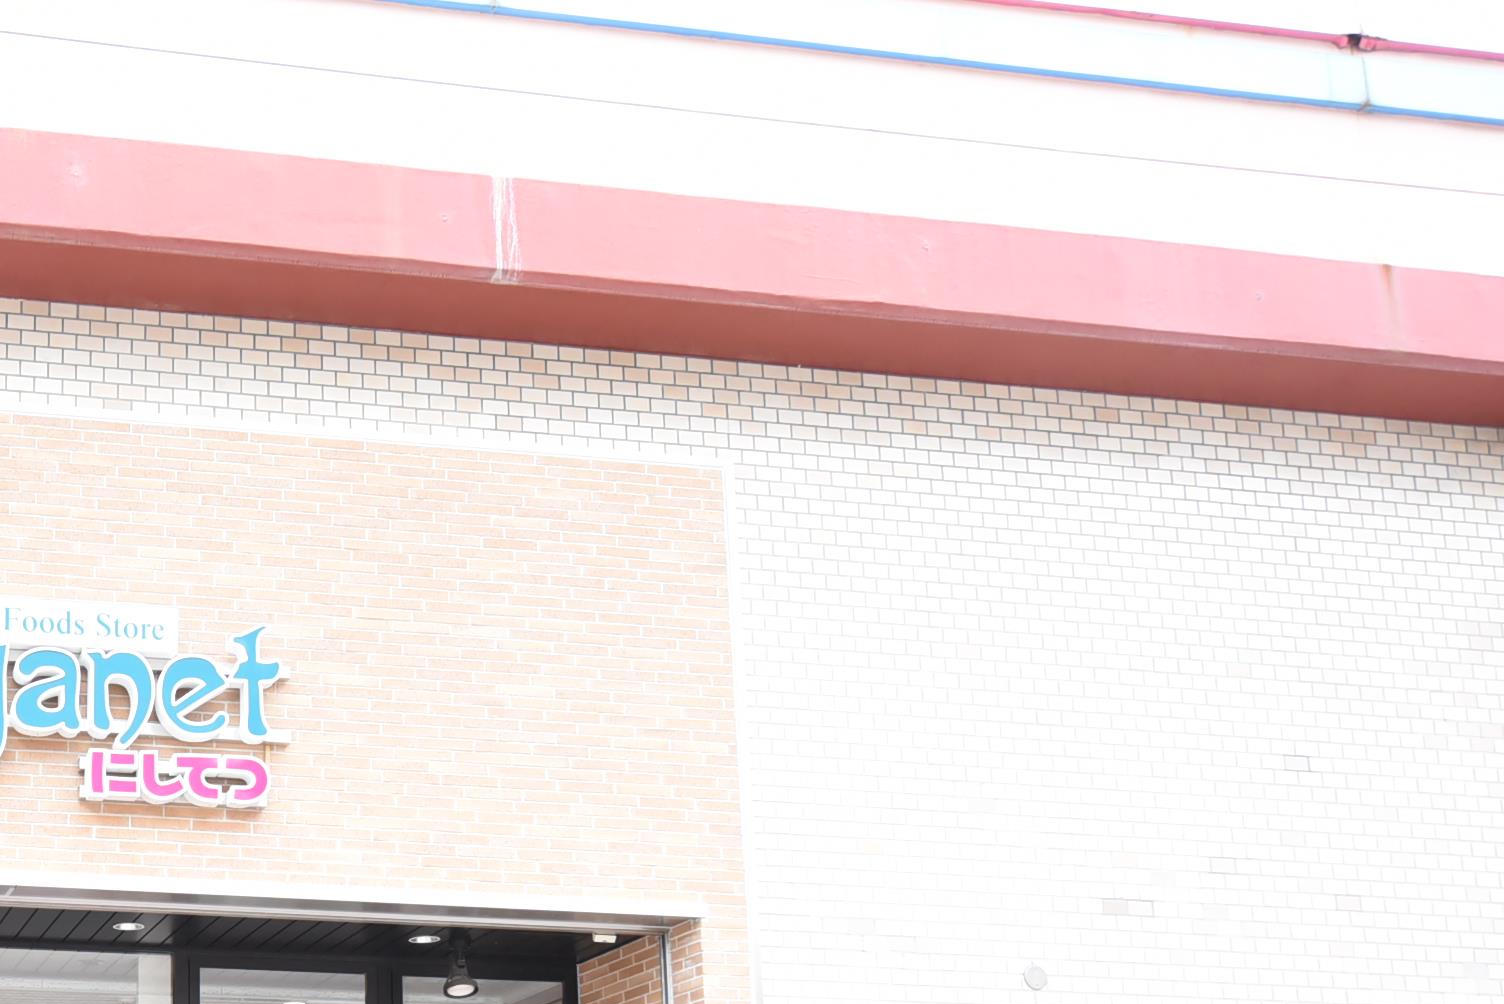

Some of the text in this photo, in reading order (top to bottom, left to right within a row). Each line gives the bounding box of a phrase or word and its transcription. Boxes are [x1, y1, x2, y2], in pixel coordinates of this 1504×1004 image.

[4, 606, 84, 636] Foods
[96, 611, 165, 641] Store
[90, 750, 270, 801] にしてつ
